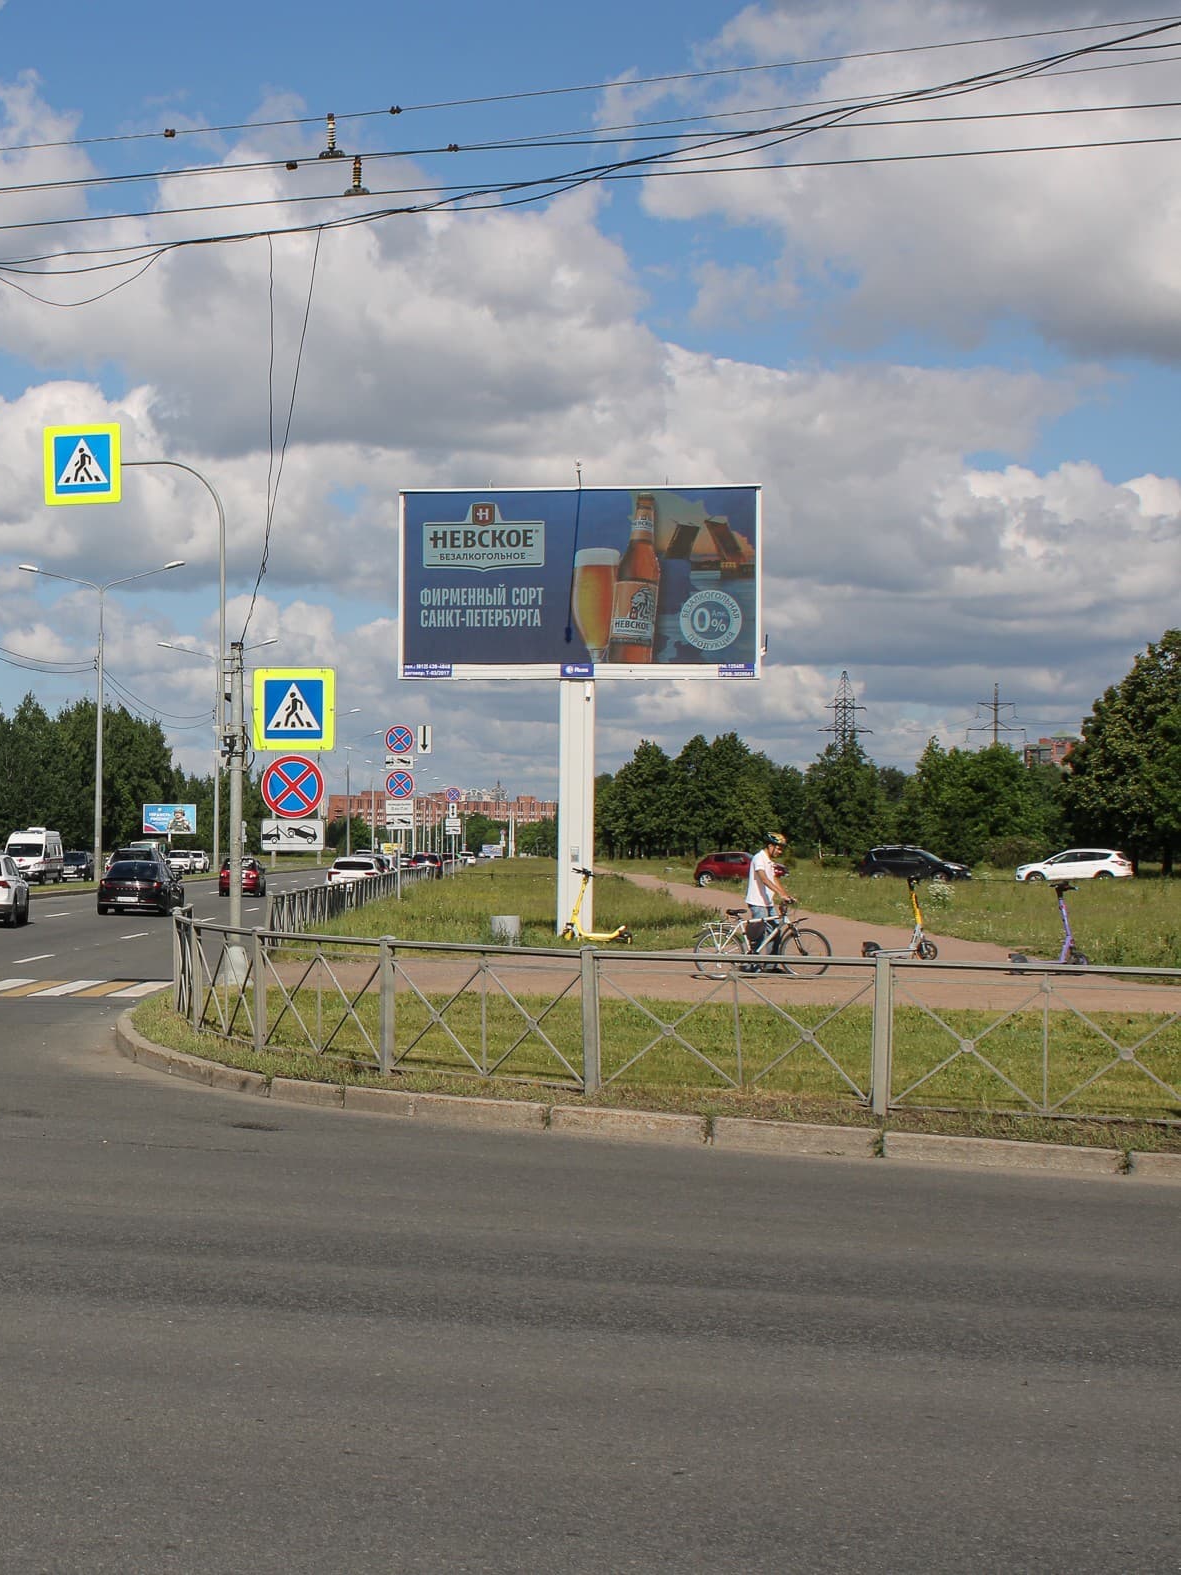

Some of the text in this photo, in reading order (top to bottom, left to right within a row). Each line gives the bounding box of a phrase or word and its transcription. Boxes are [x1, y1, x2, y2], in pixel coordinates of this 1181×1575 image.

[430, 529, 534, 548] НЕВСКОЕ
[439, 552, 526, 561] БЕЗАЛКОГОЛЬНОЕ
[420, 583, 544, 606] ФИРМЕННЫЙ СОРТ
[682, 591, 740, 619] БЕЗАЛКОГОЛЬНАЯ
[420, 608, 542, 628] САНКТ-ПЕТЕРБУРГА
[687, 631, 733, 650] ПРОДУКЦИЯ
